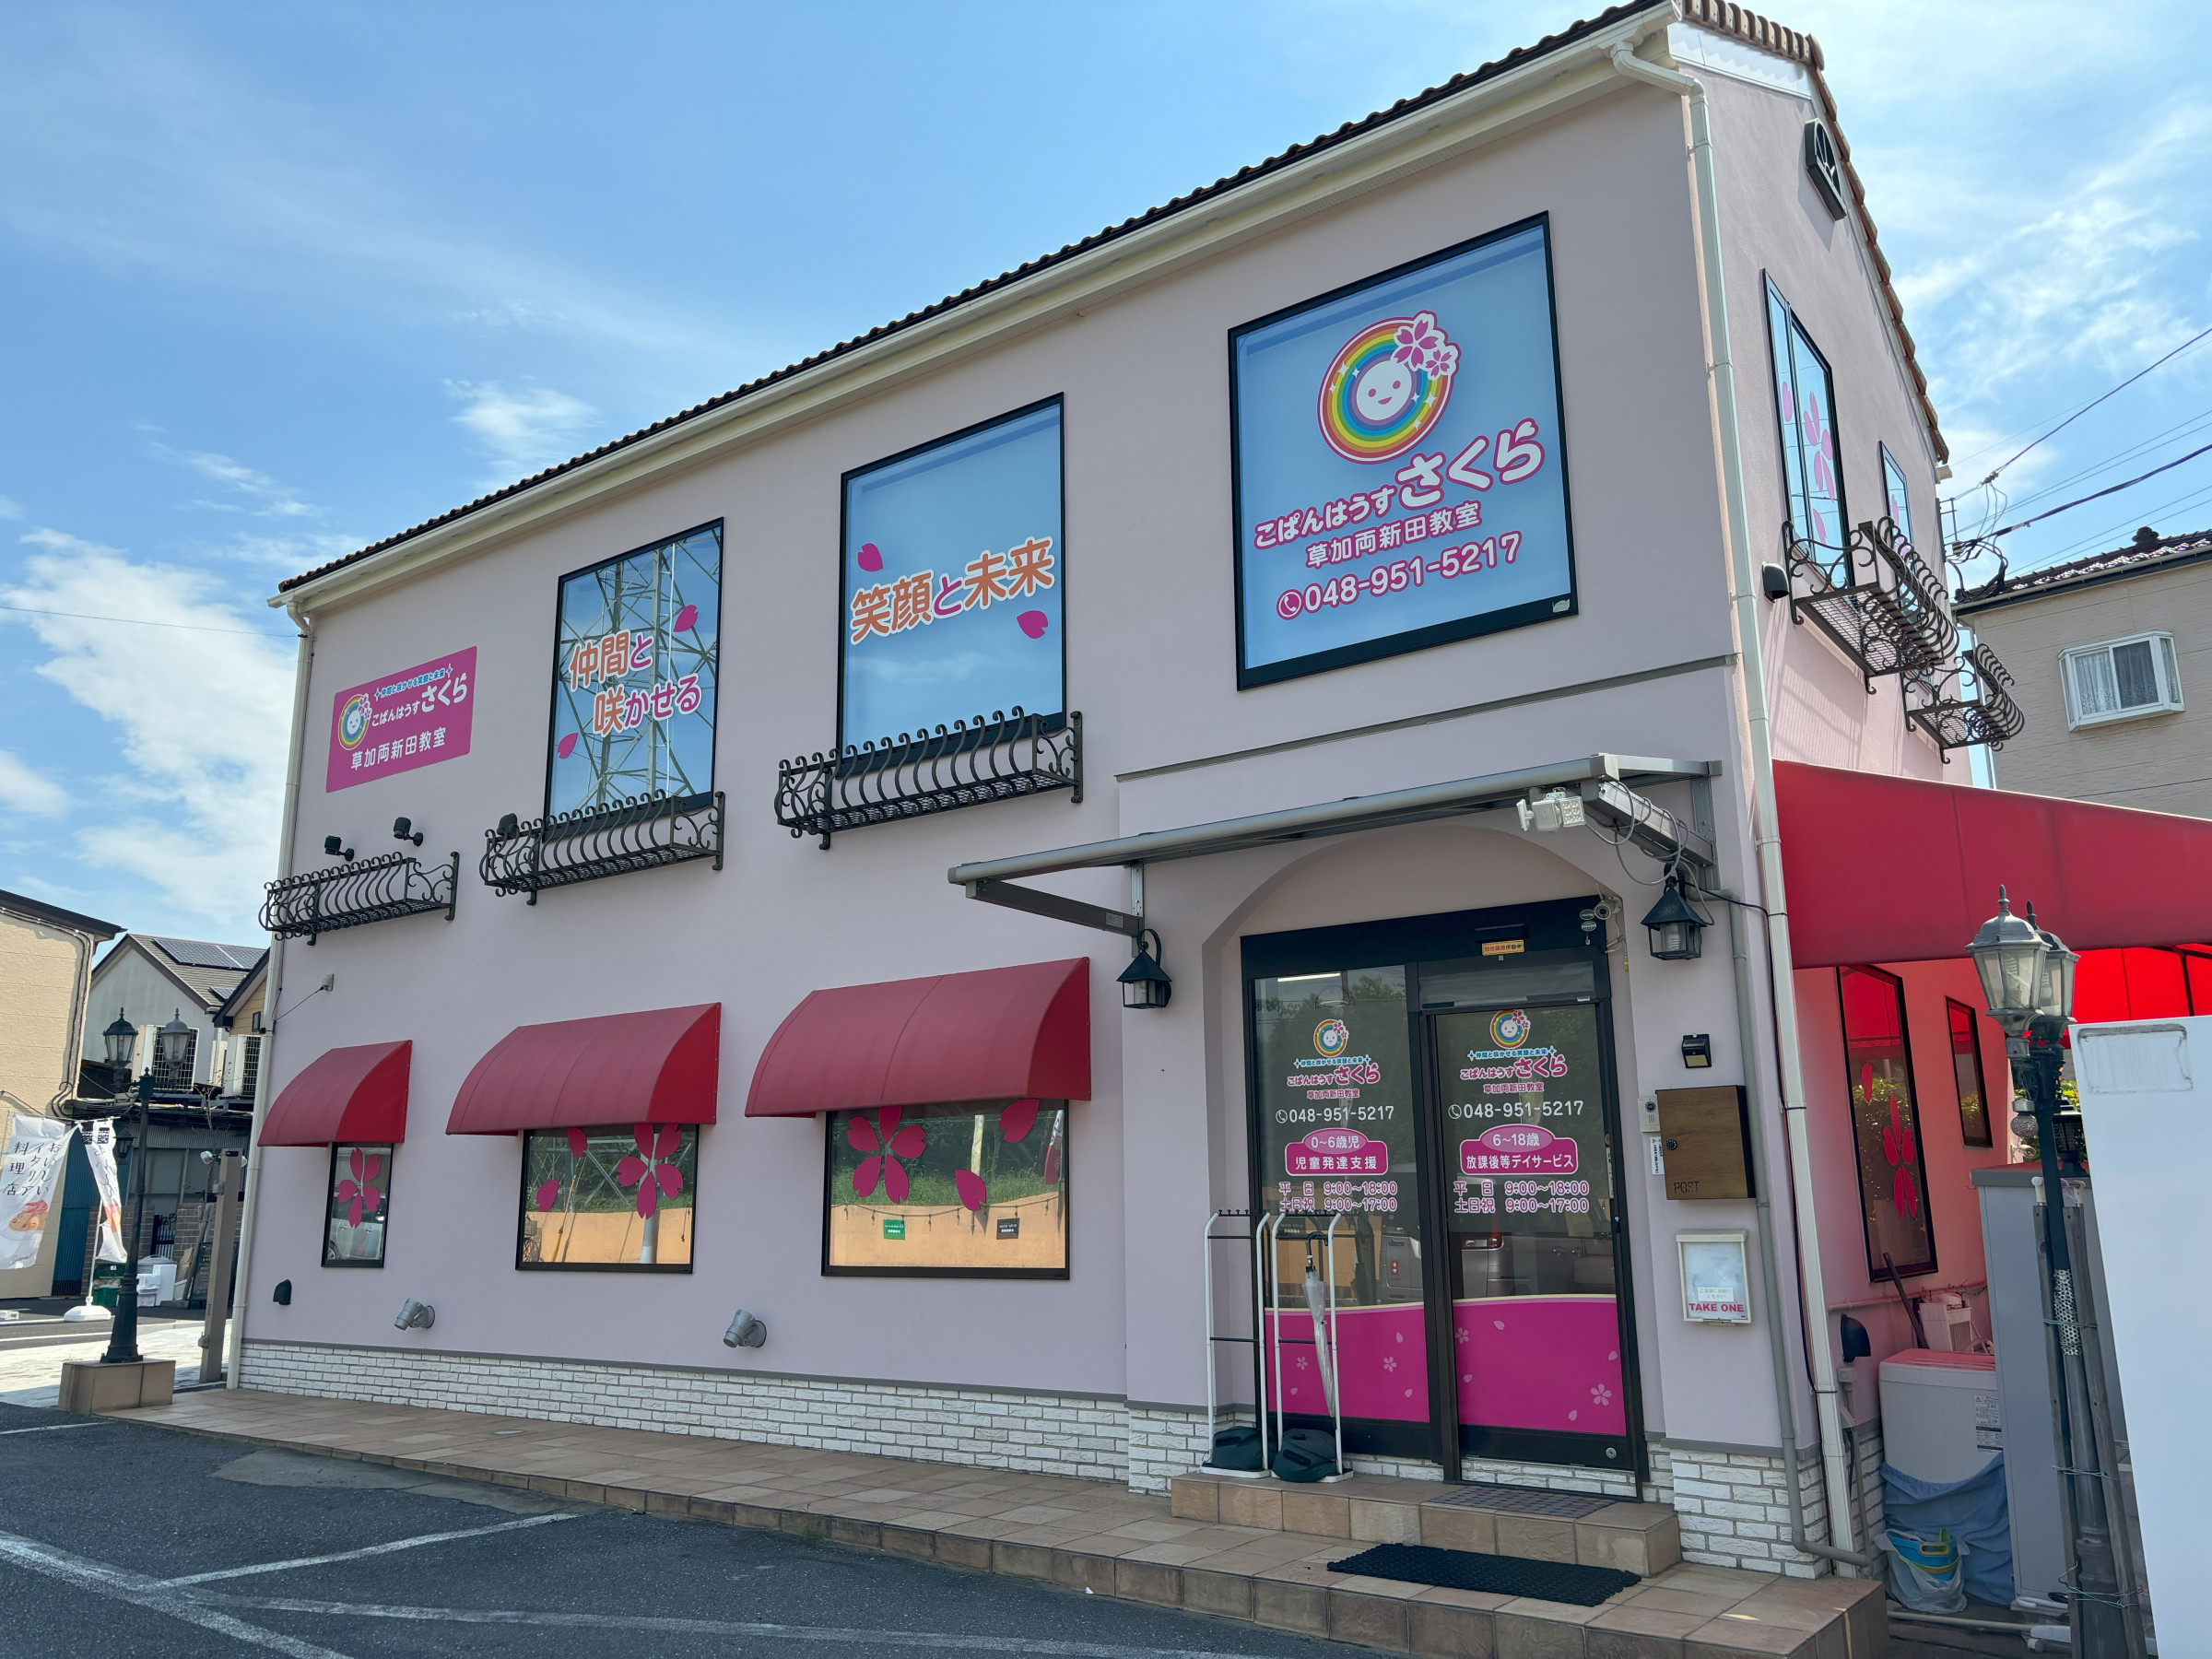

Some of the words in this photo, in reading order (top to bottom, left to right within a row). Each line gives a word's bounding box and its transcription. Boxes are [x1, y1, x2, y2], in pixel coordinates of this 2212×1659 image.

[1254, 418, 1545, 548] こぱんはうすさくら
[1304, 500, 1481, 568] 草加両新田教室
[1302, 531, 1522, 614] 048-951-5217
[849, 535, 1056, 645] 笑顔と未来
[569, 629, 654, 692] 仲間と
[371, 672, 467, 727] こぱんはうすさくら
[593, 673, 701, 737] 咲かせる
[350, 726, 446, 771] 草加両新田教室
[1287, 1063, 1381, 1087] こぱんはうすさくら
[1460, 1054, 1568, 1080] こぱんはうすさくら
[1307, 1088, 1360, 1100] 草加両新田教室
[1483, 1082, 1544, 1094] 草加両新田教室
[1289, 1106, 1394, 1123] 048-951-5217
[1464, 1100, 1583, 1119] 048-951-5217
[2, 1141, 29, 1196] 料理店
[21, 1142, 45, 1196] イタリア
[37, 1142, 62, 1196] おいしい
[1295, 1156, 1377, 1170] 児童発達支援
[1466, 1154, 1574, 1170] 放課後等デイサービス
[1674, 1181, 1700, 1194] POST
[1279, 1197, 1315, 1212] 土日祝
[1454, 1197, 1495, 1213] 土日祝
[1688, 1302, 1718, 1312] TAKE
[1720, 1303, 1745, 1312] ONE
